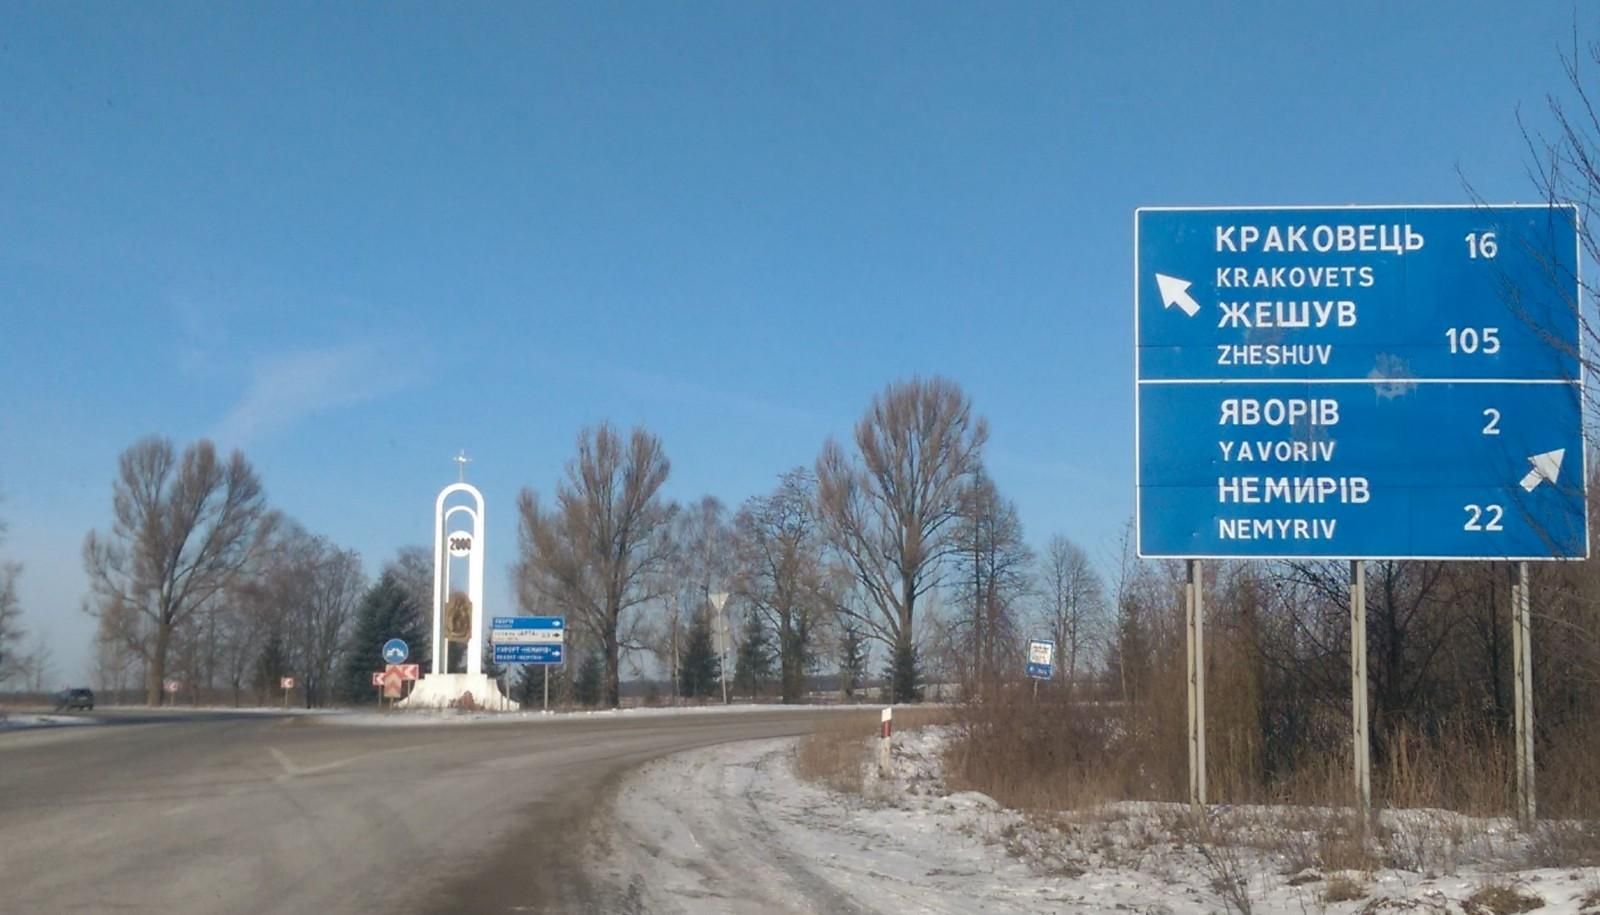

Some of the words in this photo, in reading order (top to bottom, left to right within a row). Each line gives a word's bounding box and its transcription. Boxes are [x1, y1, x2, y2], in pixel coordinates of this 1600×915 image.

[1216, 224, 1425, 255] КРАКОВЕЦЬ
[1464, 231, 1498, 259] 16
[1216, 266, 1376, 288] KRAKOVETS
[1217, 301, 1357, 328] ЖЕШУВ
[1445, 327, 1501, 355] 105
[1217, 345, 1332, 365] ZHESHUV
[1219, 398, 1340, 426] ЯВОРІВ
[1482, 408, 1501, 435] 2
[1219, 441, 1335, 462] YAVORIV
[1218, 476, 1371, 504] НЕМИРІВ
[1219, 519, 1337, 540] NEMYRIV
[1463, 505, 1504, 532] 22
[450, 537, 472, 551] 2000
